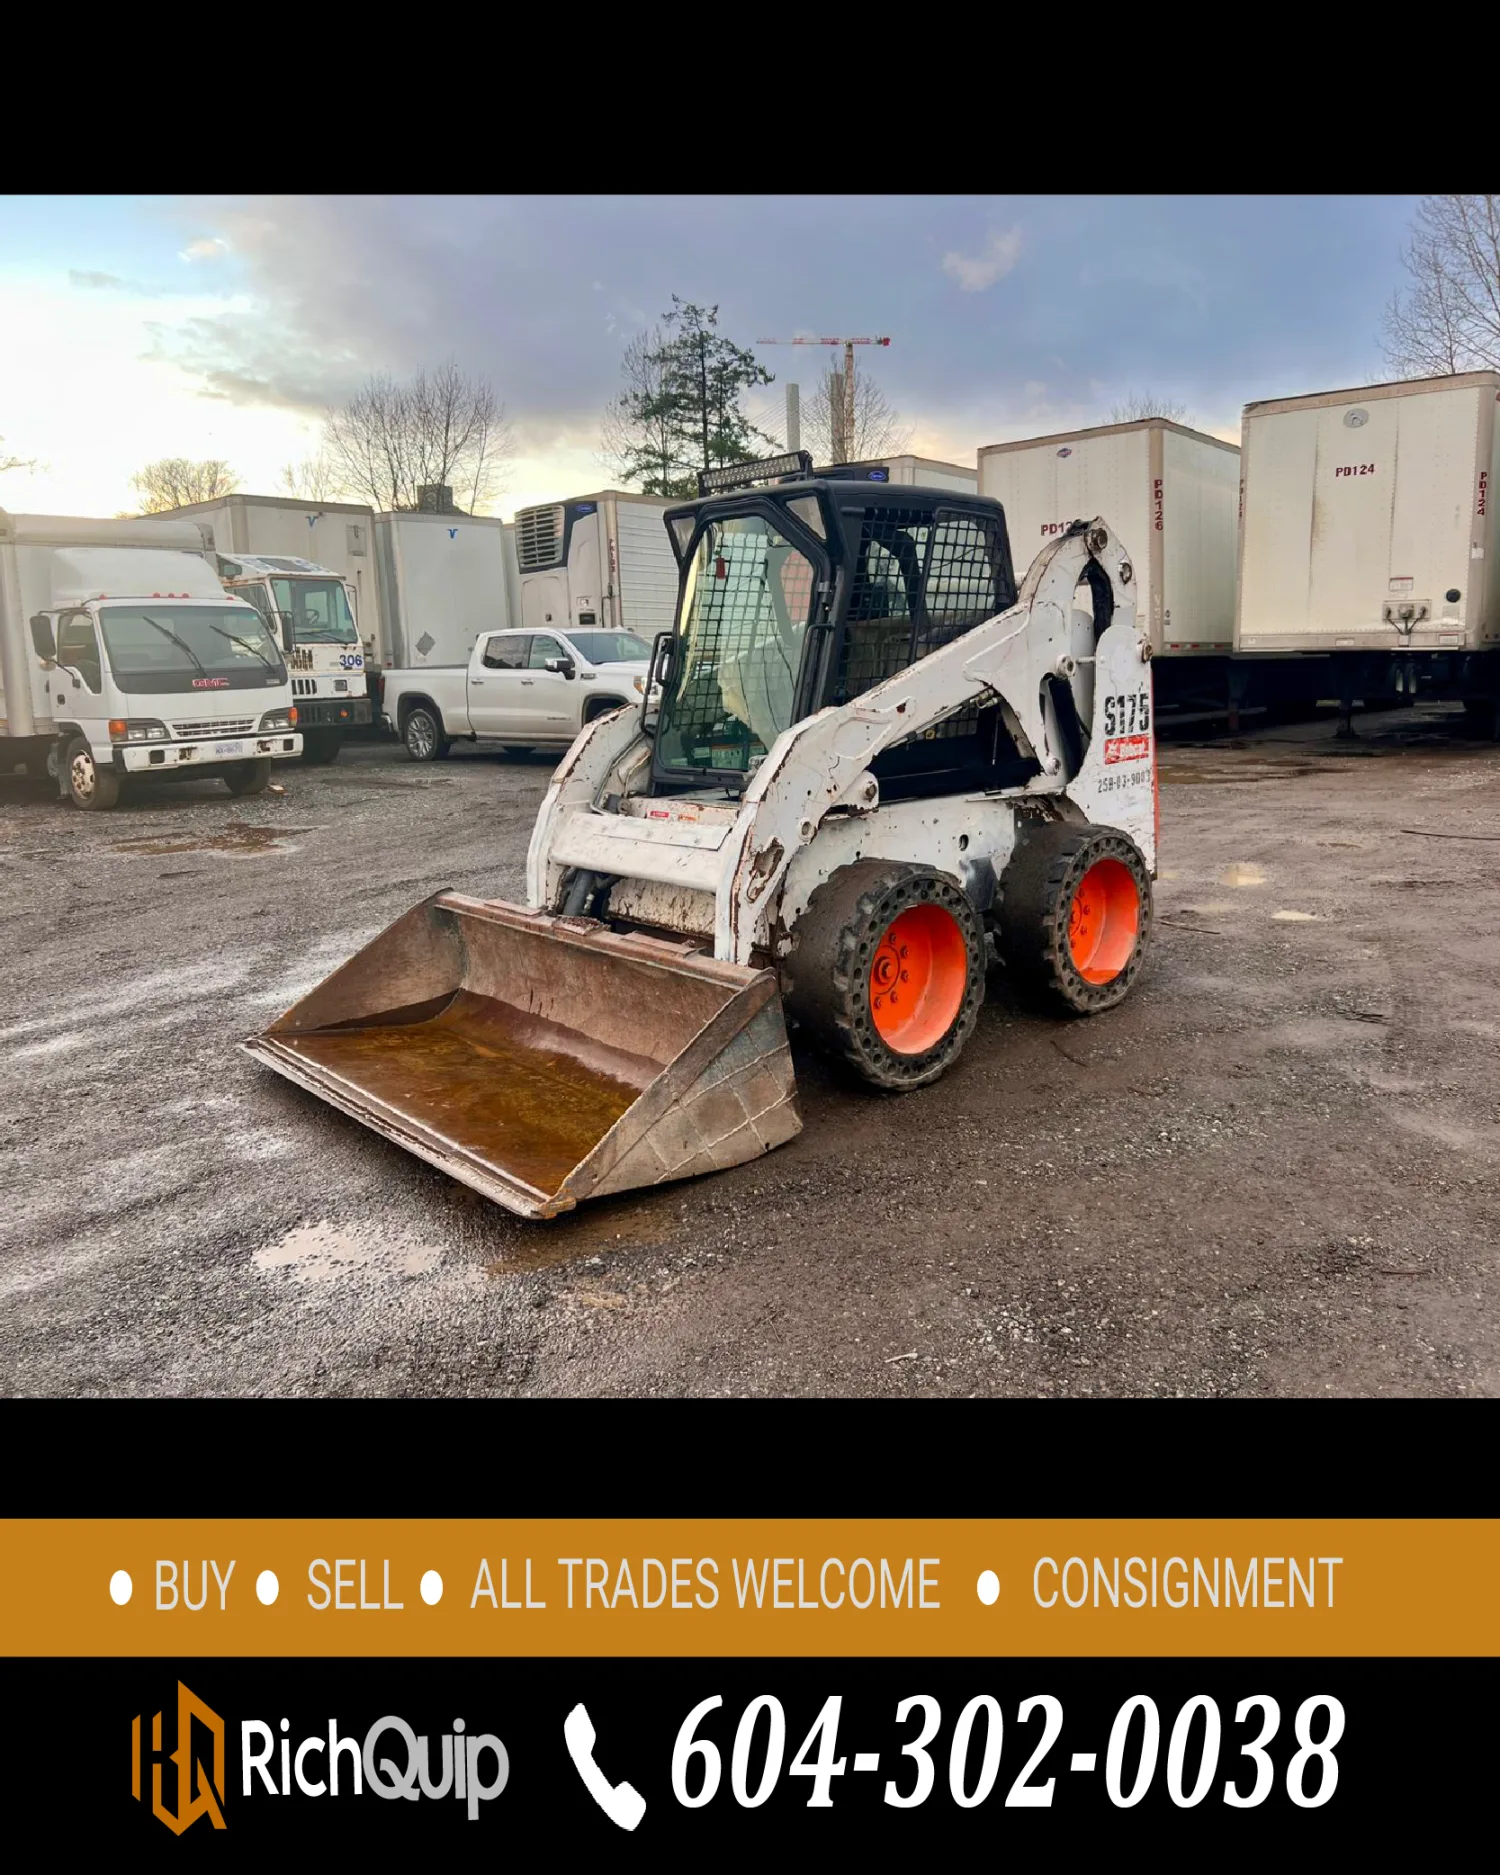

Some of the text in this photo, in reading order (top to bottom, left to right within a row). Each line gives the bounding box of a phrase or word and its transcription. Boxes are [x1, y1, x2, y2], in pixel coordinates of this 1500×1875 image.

[1335, 464, 1375, 477] PD124
[1153, 479, 1163, 531] PD126
[1477, 471, 1487, 516] PD124
[1040, 521, 1074, 536] PD12
[339, 654, 363, 667] 306
[1104, 693, 1149, 736] S175
